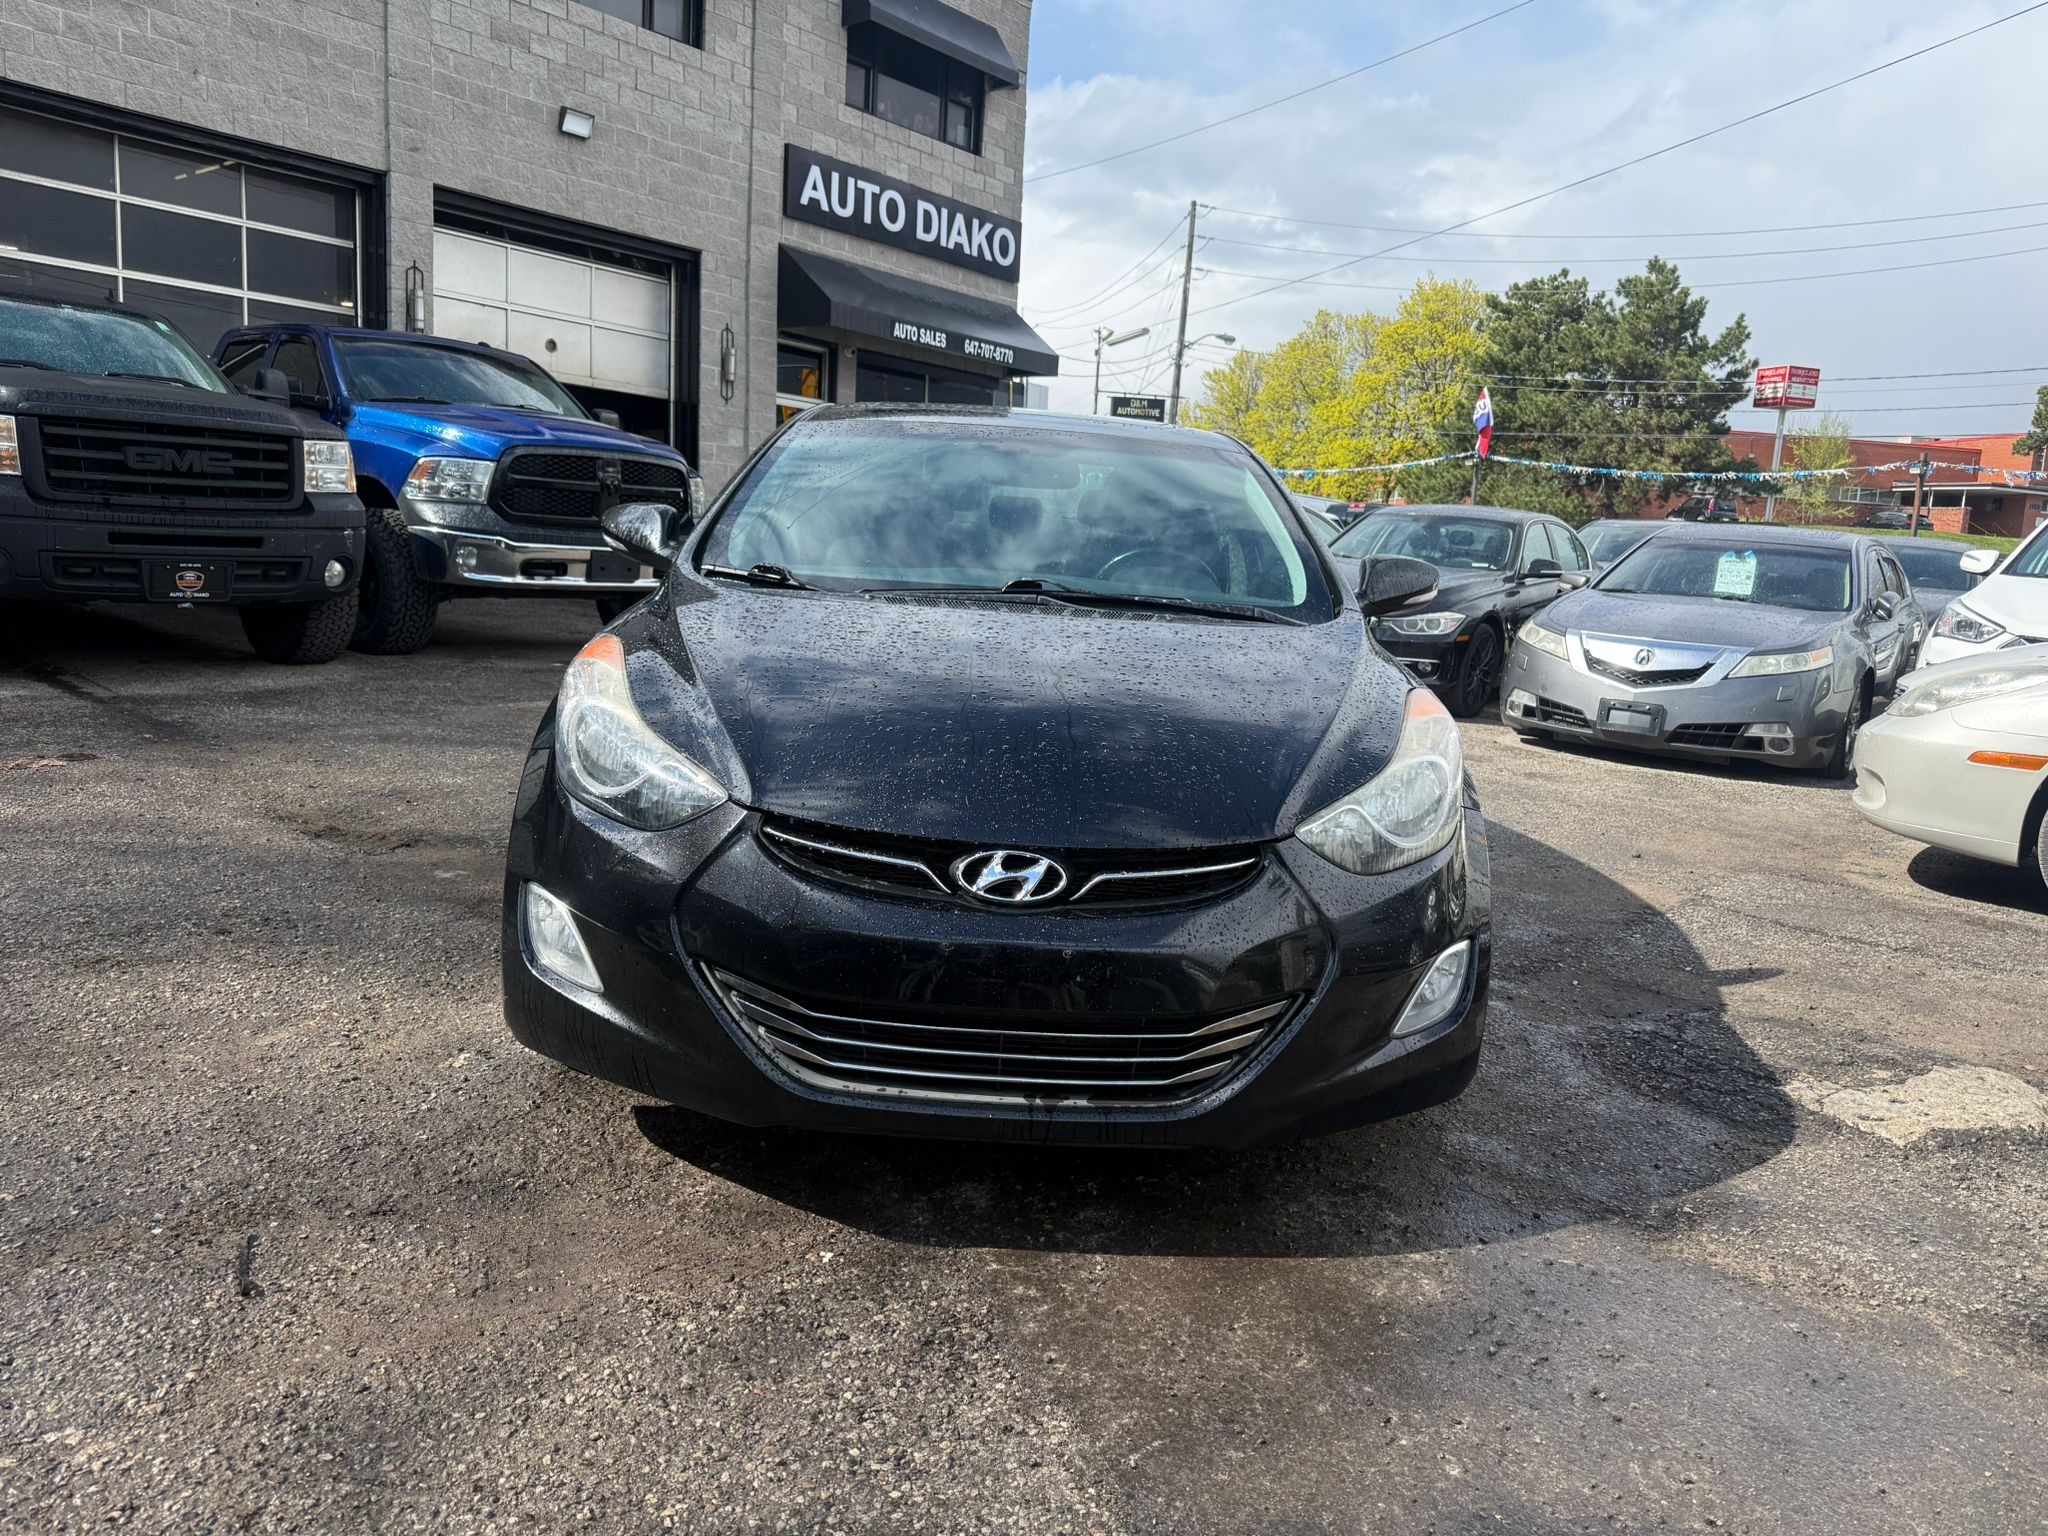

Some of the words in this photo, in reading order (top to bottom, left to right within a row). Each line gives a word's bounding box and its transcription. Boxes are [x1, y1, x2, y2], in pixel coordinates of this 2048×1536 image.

[800, 164, 906, 232] AUTO
[916, 199, 1016, 267] DIAKO
[893, 321, 918, 342] AUTO
[919, 328, 947, 348] SALES
[964, 338, 1014, 364] 647-707-8770
[1116, 406, 1161, 417] AUTOMOTIVE
[1130, 399, 1148, 408] D&M
[126, 445, 234, 475] GMC
